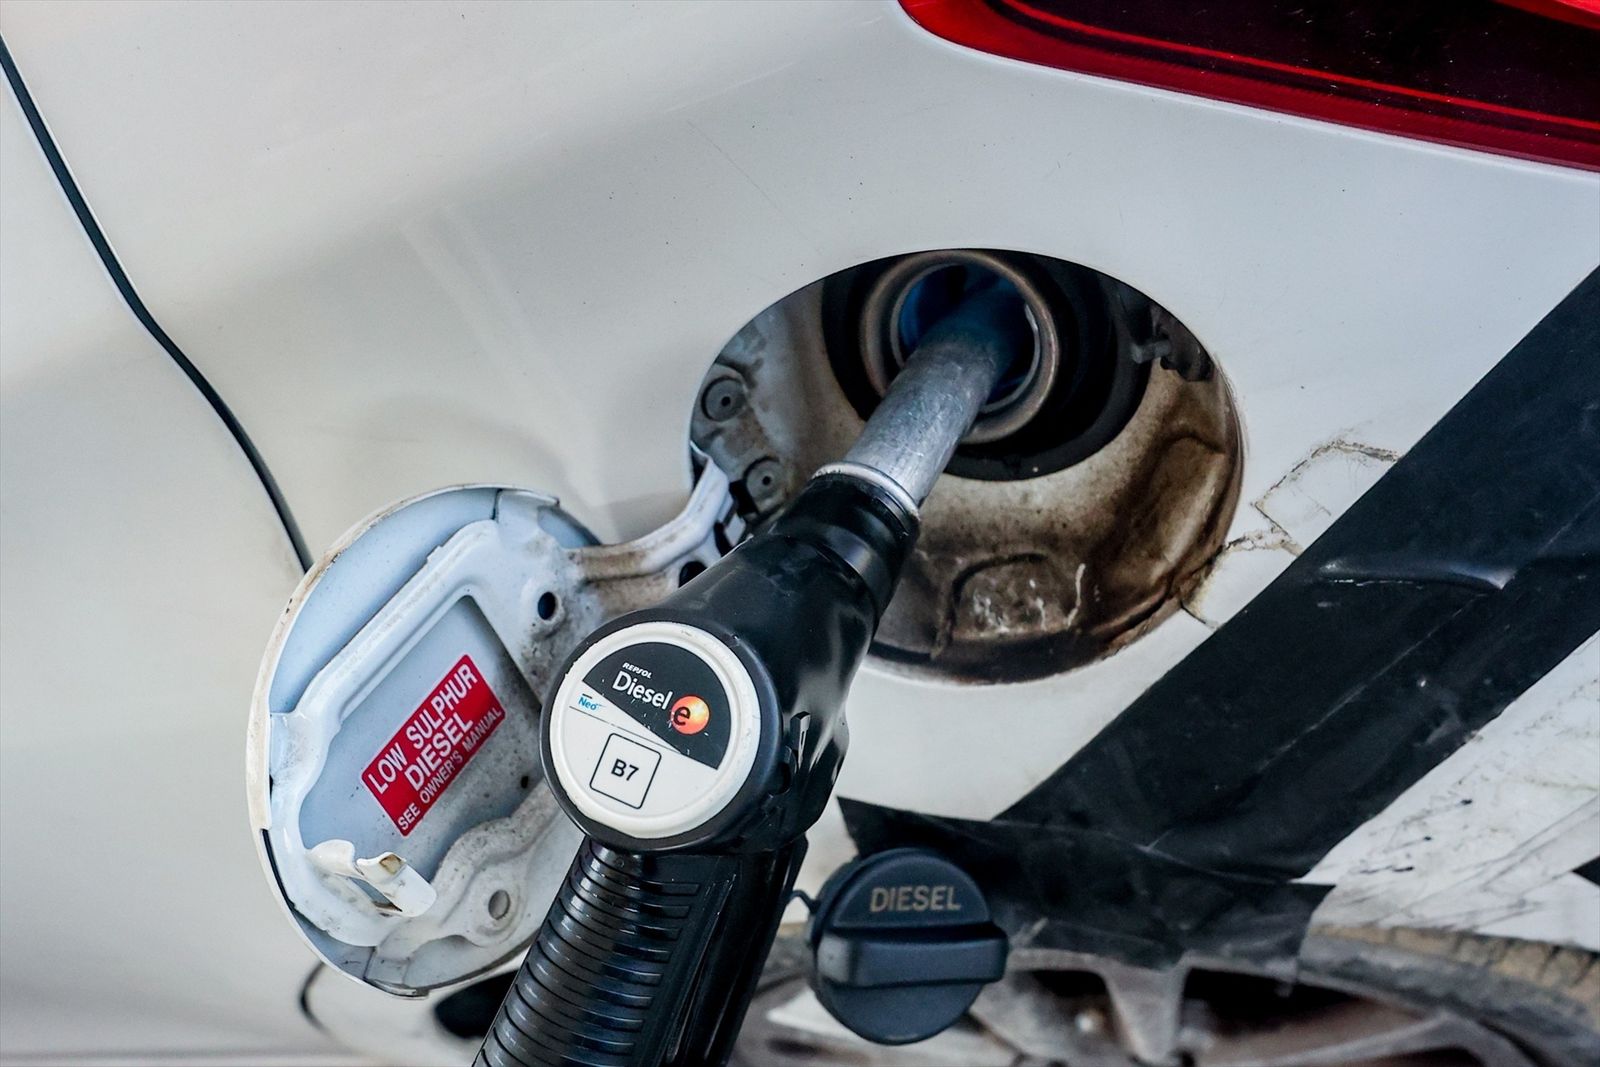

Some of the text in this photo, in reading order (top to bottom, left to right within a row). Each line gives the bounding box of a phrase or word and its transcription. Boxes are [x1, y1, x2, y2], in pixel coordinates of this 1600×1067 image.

[622, 662, 653, 679] REPSOL
[578, 696, 599, 711] Neo
[612, 670, 691, 726] Diesel e
[367, 663, 479, 795] LOW SULPHUR
[397, 706, 502, 831] SEE OWNER'S MANUAL
[404, 712, 474, 792] DIESEL
[611, 758, 640, 782] B7
[869, 885, 961, 913] DIESEL
